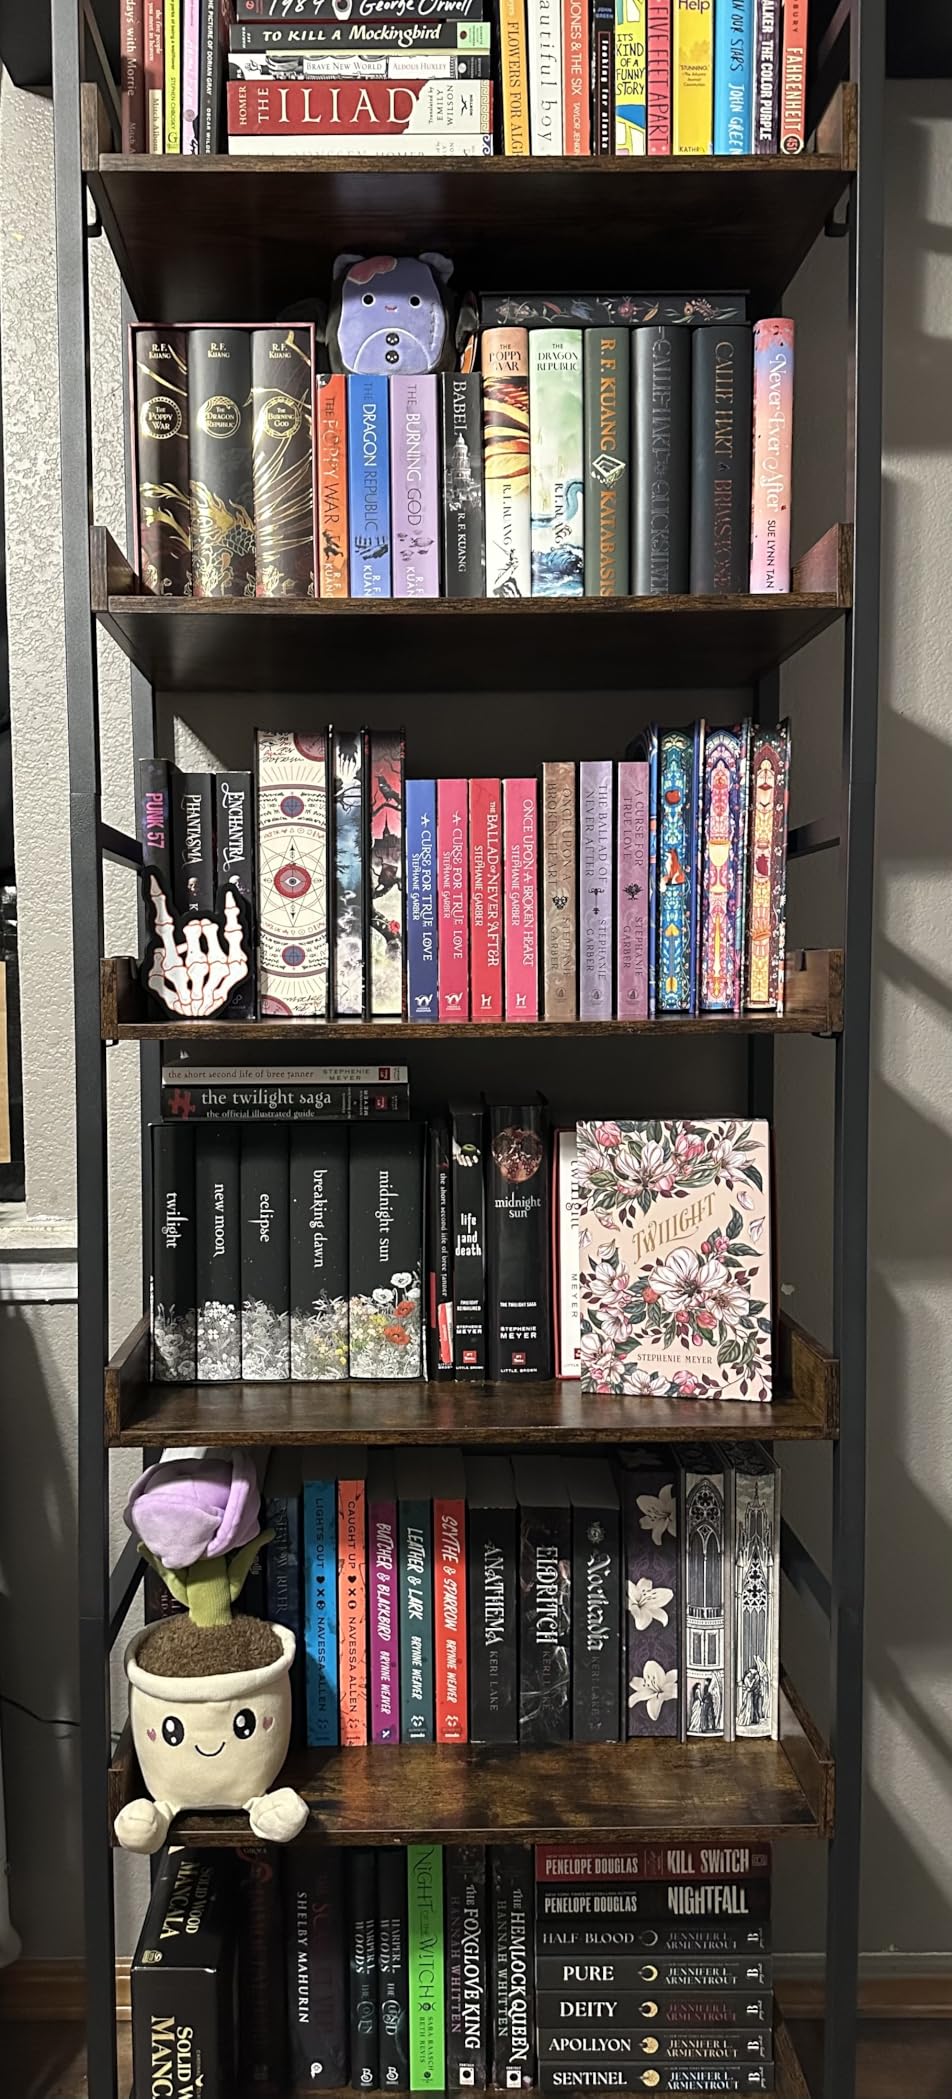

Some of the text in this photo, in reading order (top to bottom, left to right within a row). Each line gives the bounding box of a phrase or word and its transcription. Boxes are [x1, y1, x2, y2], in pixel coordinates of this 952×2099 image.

[263, 24, 442, 47] TO KILL A Mockingbird
[359, 0, 415, 17] George
[730, 14, 744, 71] OUR STARS
[307, 62, 382, 70] BRAVE NEW WORLD
[507, 22, 521, 118] FLOWERS FOR
[616, 43, 644, 56] KIND
[616, 68, 645, 80] FUNNY
[648, 7, 668, 144] FIVE FEET APART
[258, 87, 269, 123] THE
[278, 87, 417, 123] ILIAD
[538, 101, 557, 141] boy
[616, 82, 644, 95] STORY
[760, 40, 774, 140] THE COLOR PURPLE
[785, 47, 803, 151] FAHRENHEIT 451
[715, 341, 734, 404] CALLIE
[322, 397, 340, 524] THE POPPY WAR
[362, 382, 378, 532] THE DRAGON REPUBLIC
[406, 384, 422, 526] THE BURNING GOD
[600, 338, 617, 596] R. F. KUANG KATABASIS
[715, 410, 733, 458] HART
[761, 353, 787, 514] Never Ever After
[452, 380, 467, 573] BABEL R. F. KUANG
[766, 520, 776, 588] SUE LYNN TAN
[145, 792, 165, 849] PUNK 57
[181, 793, 203, 868] PHANTASMA
[222, 782, 245, 873] ENCHANTRA
[412, 854, 420, 921] STEPHANIE GARBER
[420, 813, 433, 962] A CURSE FOR TRUE LOVE
[452, 812, 464, 959] A CURSE FOR TRUE LOVE
[475, 845, 484, 927] STEPHANIE GARBER
[511, 845, 520, 926] STEPHANIE GARBER
[523, 799, 535, 967] ONCE UPON A BROKEN HEART
[202, 1089, 226, 1105] the
[233, 1089, 295, 1109] twilight
[299, 1092, 331, 1109] saga
[207, 1110, 315, 1119] the official illustrated guide
[161, 1192, 190, 1249] twilight
[213, 1183, 226, 1257] new moon
[248, 1193, 275, 1243] eclipse
[309, 1168, 328, 1268] breaking dawn
[375, 1170, 400, 1262] midnight sun
[494, 1192, 541, 1210] midnight
[509, 1208, 528, 1219] sun
[632, 1192, 717, 1265] TWILIGHT
[637, 1353, 713, 1364] STEPHENIE MEYER
[315, 1497, 325, 1569] LIGHTS OUT
[347, 1501, 356, 1570] CAUGHT UP
[441, 1515, 461, 1564] SCYTHE
[376, 1522, 392, 1641] BUTCHER & BLACKBIRD
[406, 1528, 425, 1620] LEATHER & LARK
[441, 1577, 461, 1632] SPARROW
[535, 1546, 558, 1644] ELDRITCH
[586, 1553, 612, 1651] Nocticadia
[484, 1543, 504, 1711] ANATHEMA KERI LAKE
[317, 1616, 327, 1712] NAVESSA ALLEN
[349, 1616, 358, 1713] NAVESSA ALLEN
[411, 1635, 423, 1700] BRYNNE WEAVER
[158, 1860, 200, 1940] MANCALA
[545, 1857, 638, 1875] PENELOPE DOUGLAS
[668, 1885, 749, 1914] NIGHTFALL
[545, 1896, 637, 1913] PENELOPE DOUGLAS
[296, 1891, 310, 2024] SHELBY MAHURIN
[460, 1884, 483, 2049] THE FOXGLOVE KING
[497, 1900, 508, 2037] HANNAH WHITTEN
[507, 1888, 527, 2063] THE HEMLOCK QUEEN
[563, 1966, 614, 1981] PURE
[665, 1976, 738, 1984] ARMENTROUT
[668, 1967, 718, 1976] JENNIFER
[560, 2001, 618, 2016] DEITY
[176, 2025, 194, 2082] SOLID
[548, 2038, 631, 2051] APOLLYON
[552, 2072, 628, 2085] SENTINEL
